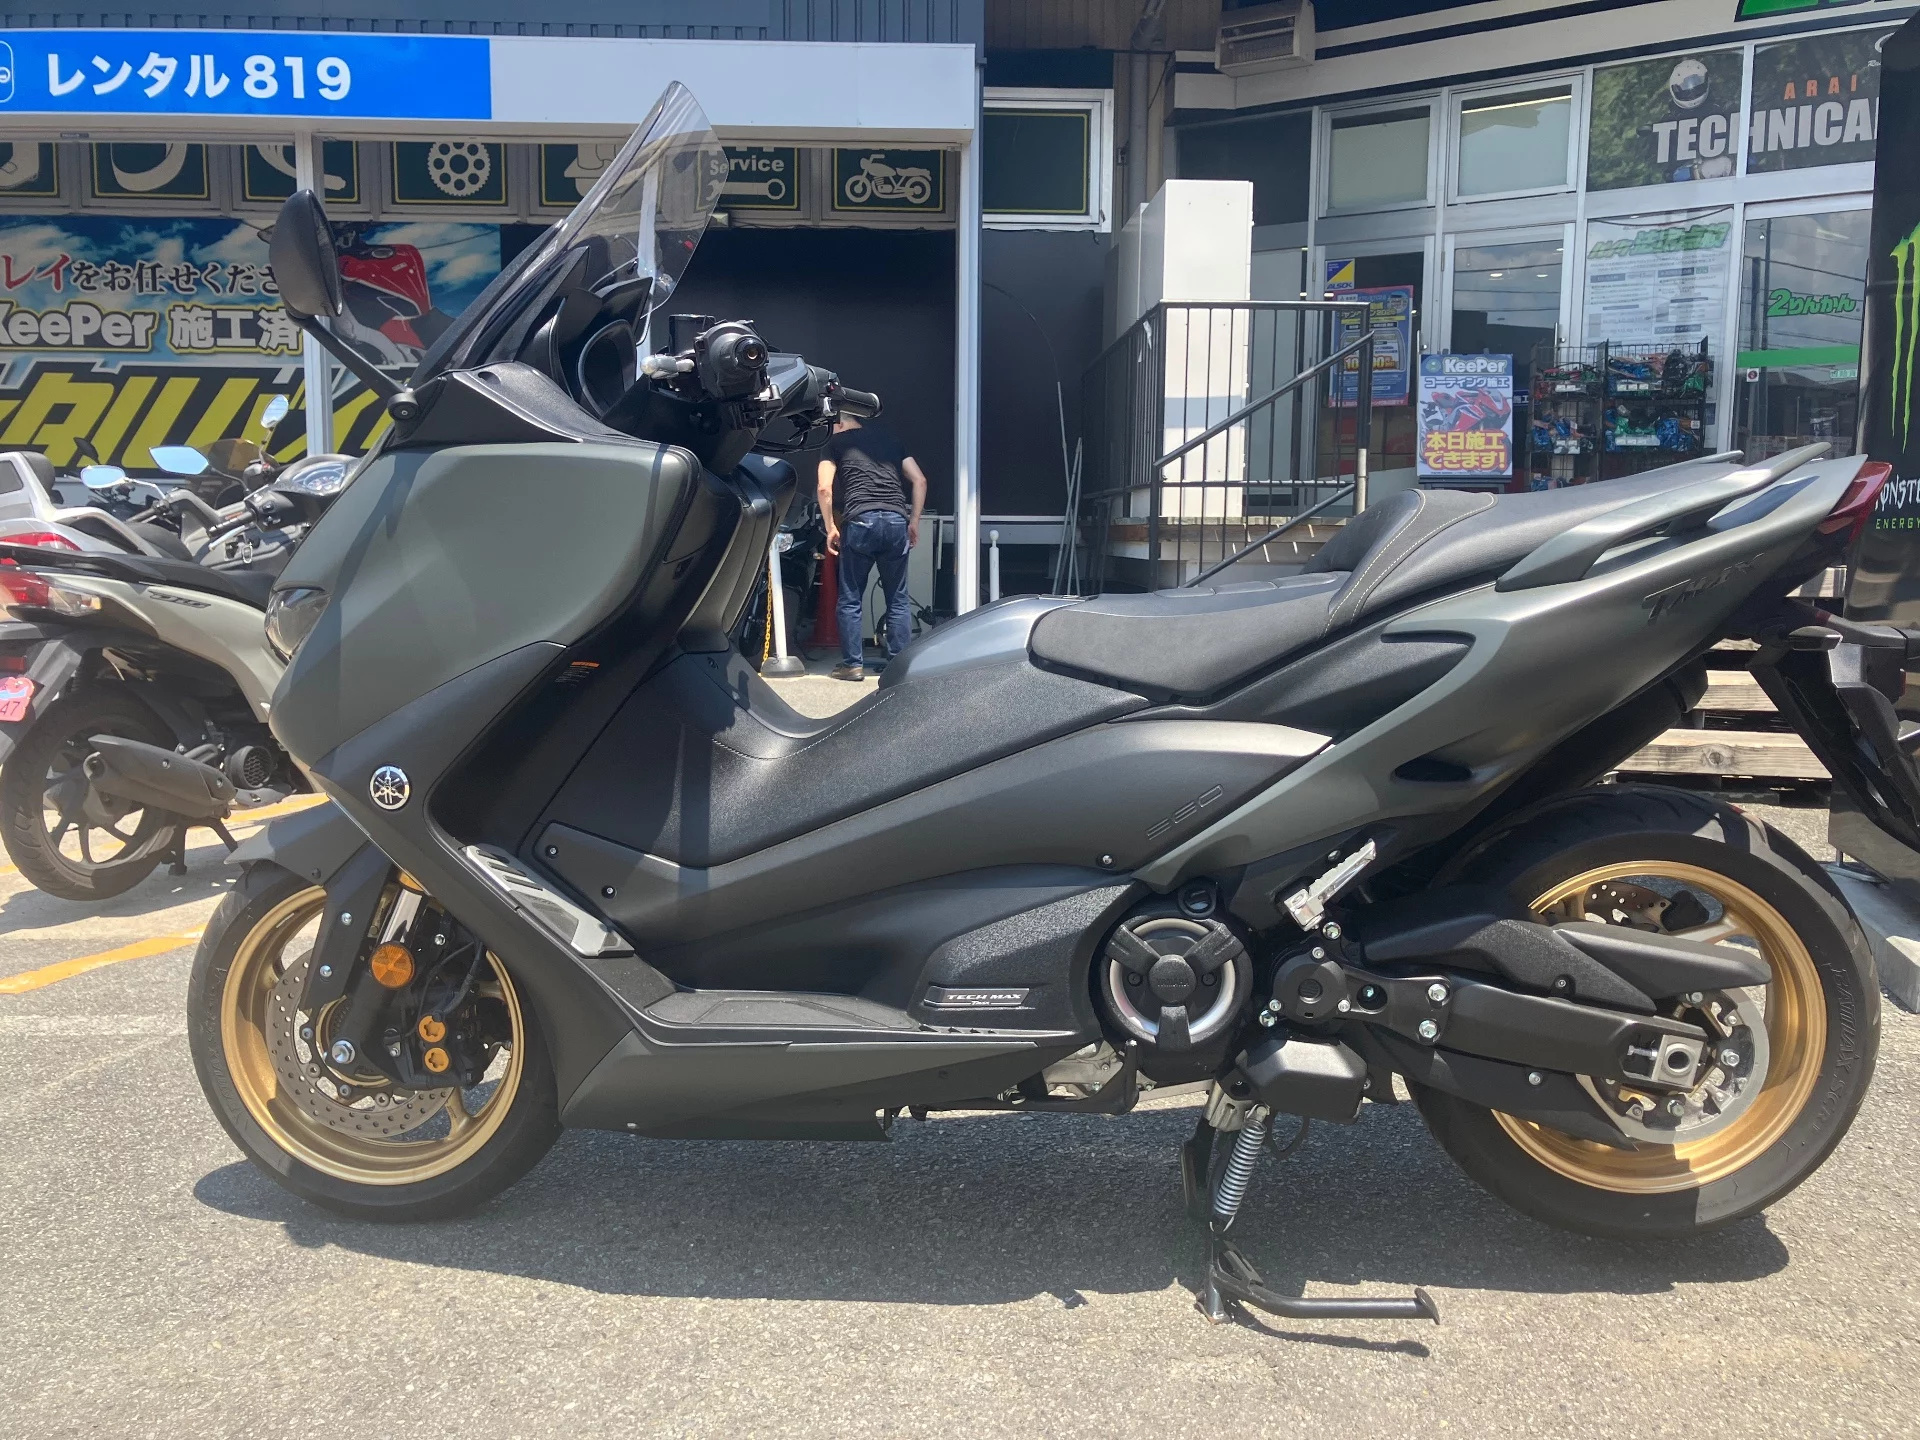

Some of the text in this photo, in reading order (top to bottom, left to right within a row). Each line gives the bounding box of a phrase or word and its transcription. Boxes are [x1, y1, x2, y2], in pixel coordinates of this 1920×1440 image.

[1784, 74, 1857, 100] ARAI
[1653, 97, 1879, 163] TECHNICA
[709, 155, 785, 176] Service
[1327, 282, 1352, 290] ALSOK
[1767, 288, 1857, 317] 2りんかん
[1445, 358, 1505, 373] KeePer
[1425, 377, 1509, 388] コーティング施工
[1427, 431, 1504, 450] 本日施工
[1425, 451, 1505, 469] できます!
